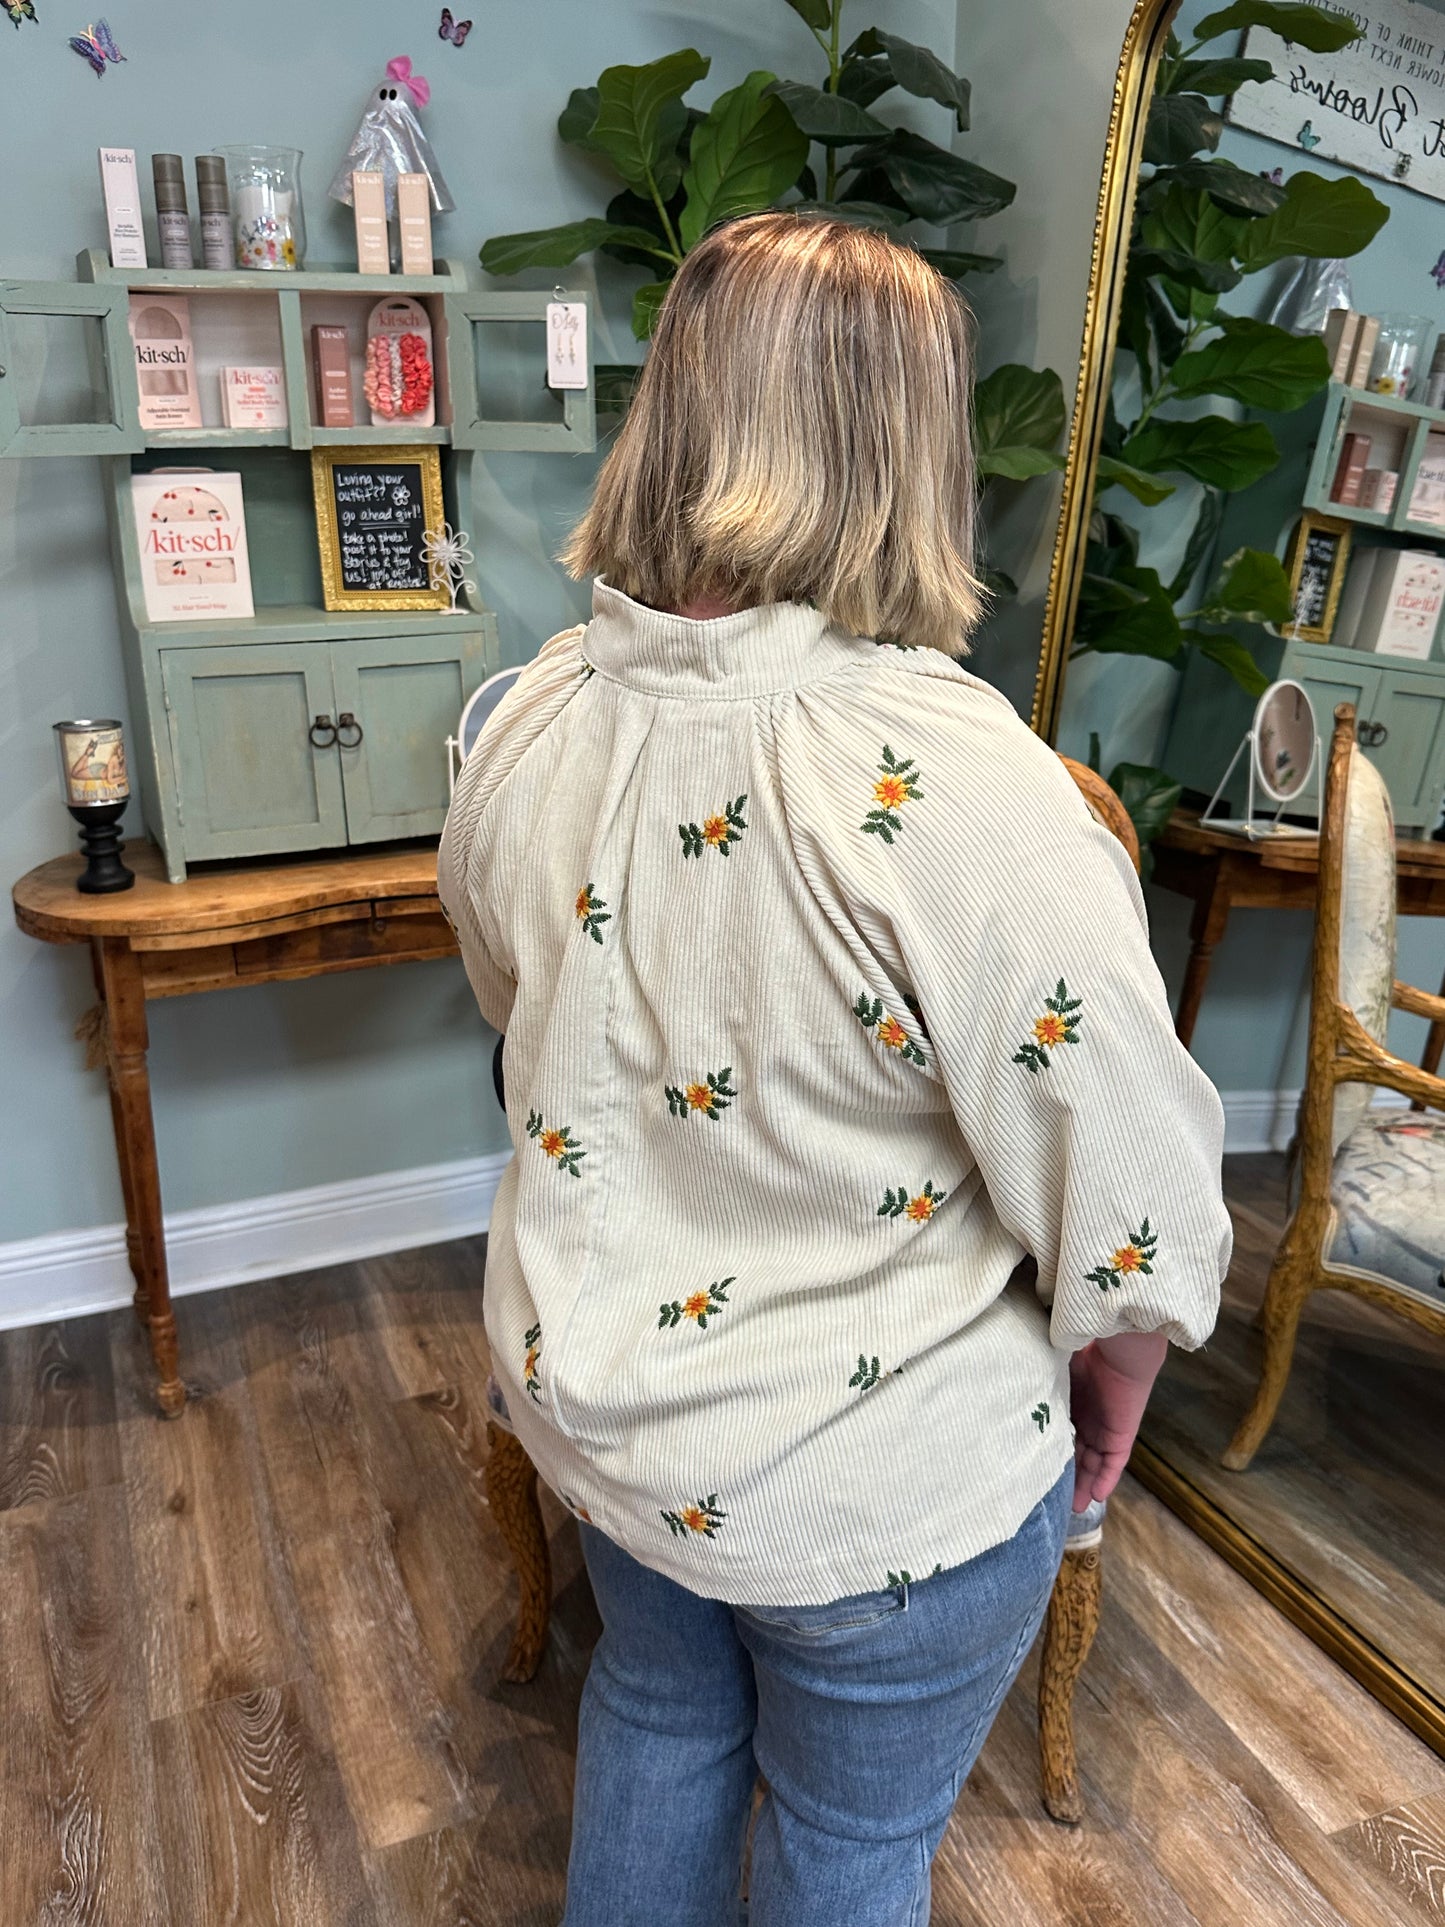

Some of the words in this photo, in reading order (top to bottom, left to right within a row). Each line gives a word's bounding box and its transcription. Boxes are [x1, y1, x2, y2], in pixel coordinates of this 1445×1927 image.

[337, 472, 373, 491] Loving
[376, 474, 404, 490] your
[342, 510, 356, 526] go
[360, 507, 392, 520] ahead
[343, 531, 365, 545] take
[366, 533, 376, 542] a
[343, 545, 366, 560] post
[368, 544, 377, 555] it
[379, 545, 391, 555] to
[392, 545, 413, 558] your
[393, 556, 411, 571] tag
[369, 581, 382, 590] at
